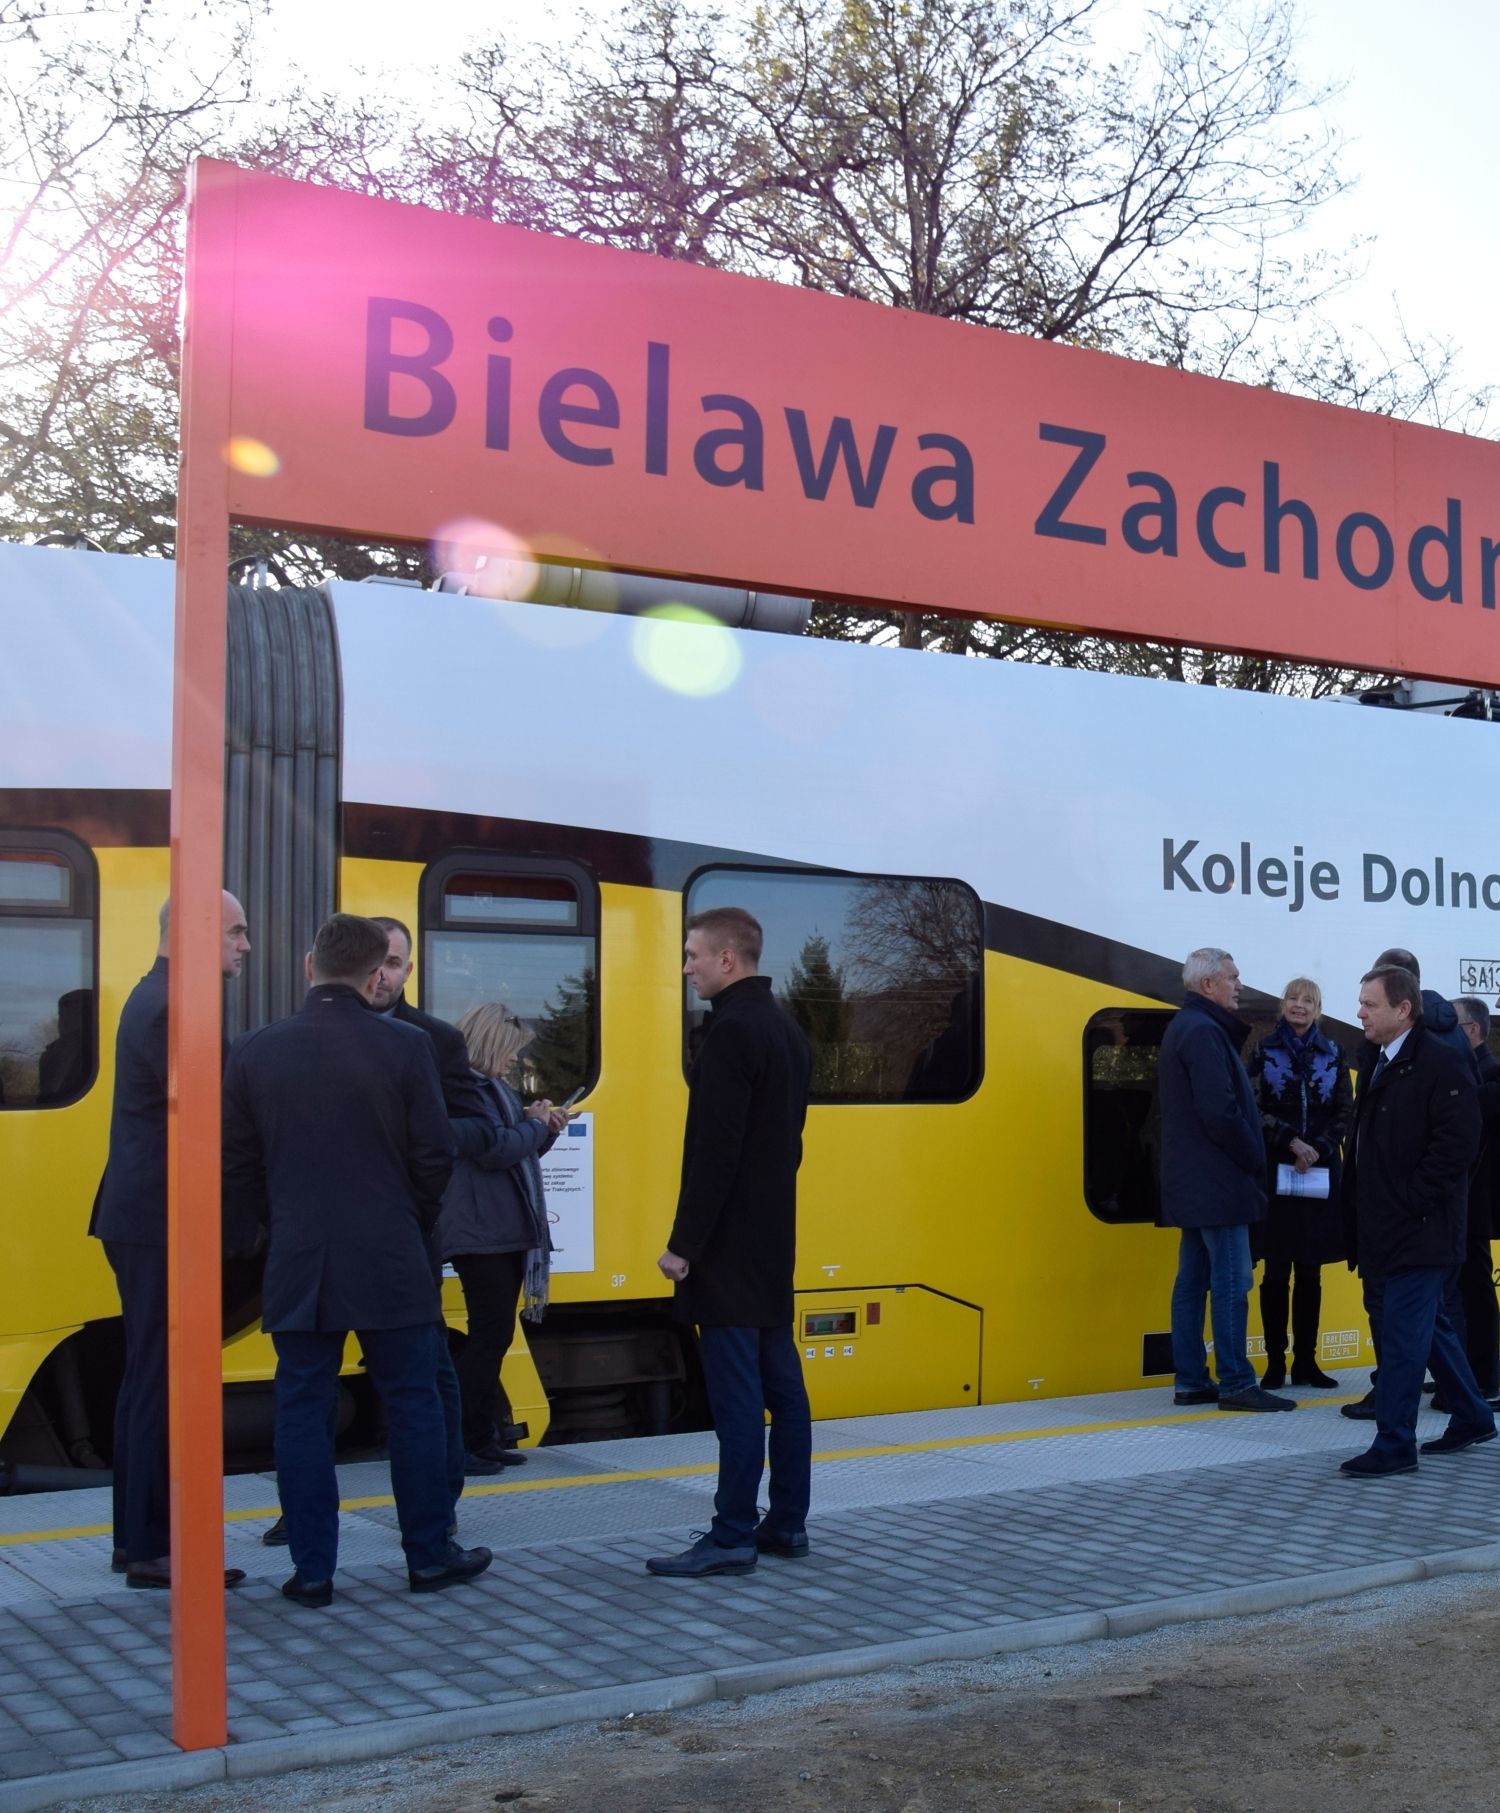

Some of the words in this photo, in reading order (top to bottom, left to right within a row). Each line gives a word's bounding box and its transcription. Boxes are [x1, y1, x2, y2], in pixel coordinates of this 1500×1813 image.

[362, 296, 977, 525] Bielawa
[1162, 838, 1340, 912] Koleje
[611, 1274, 627, 1288] 3P
